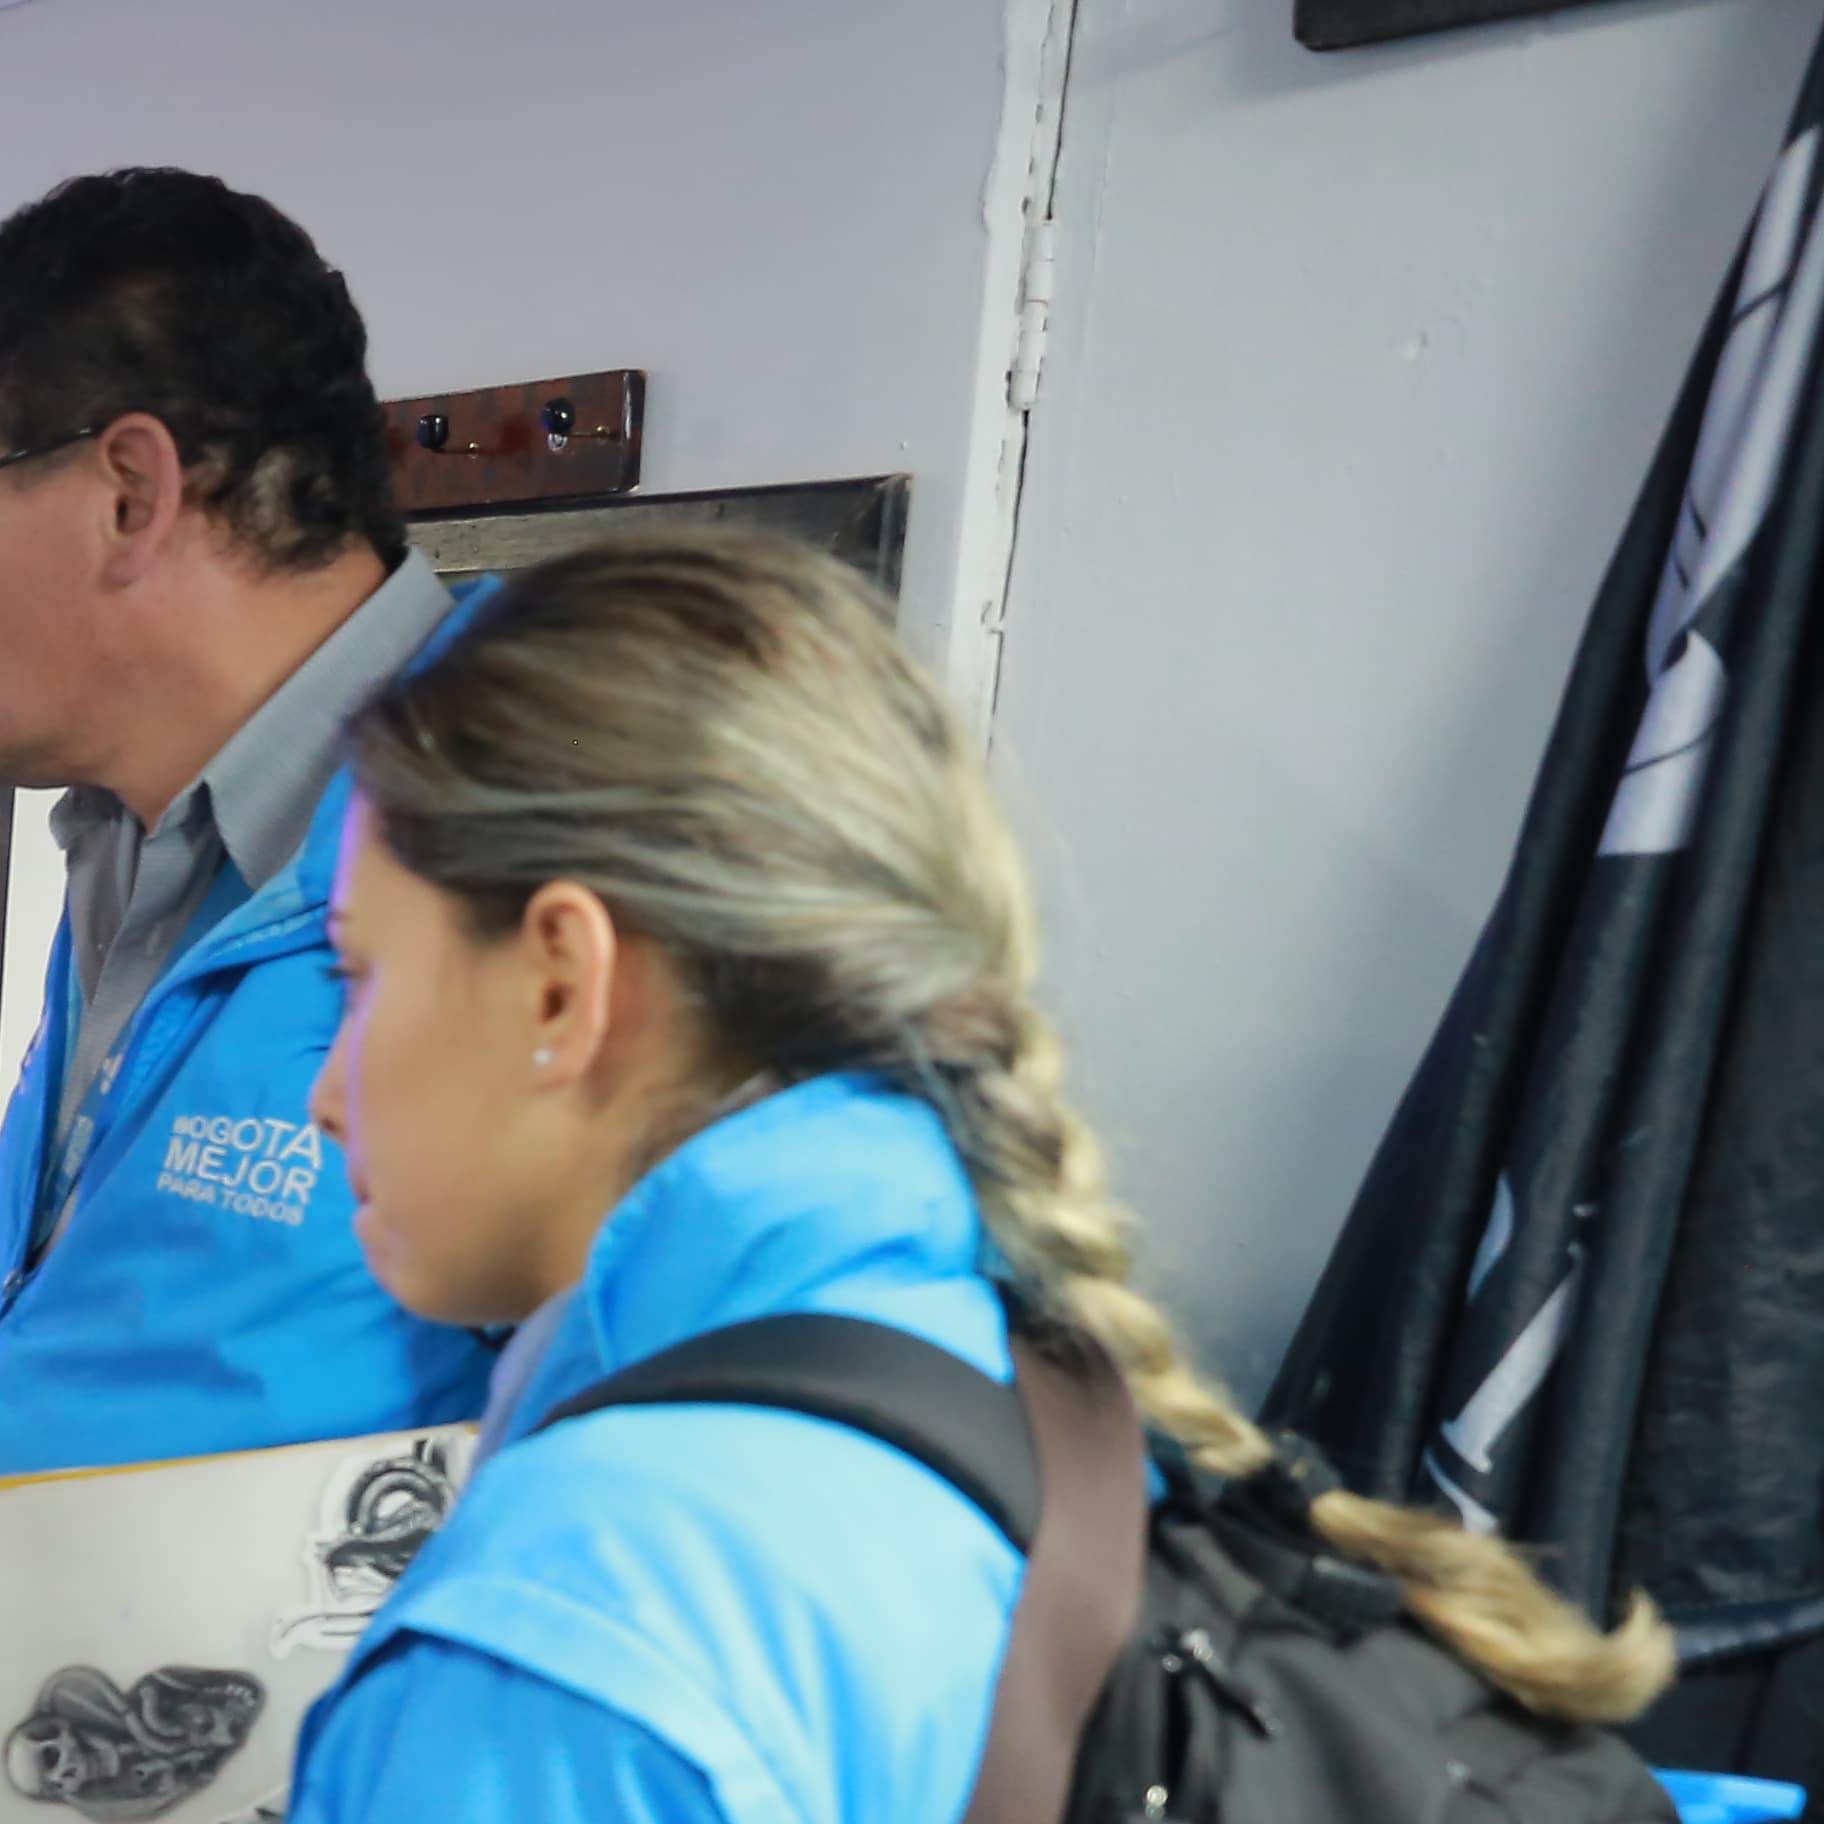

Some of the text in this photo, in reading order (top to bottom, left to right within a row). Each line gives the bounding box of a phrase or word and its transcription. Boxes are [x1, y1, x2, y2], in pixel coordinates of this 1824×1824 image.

[156, 1171, 304, 1226] PARA TODOS
[164, 1136, 317, 1205] MEJOR
